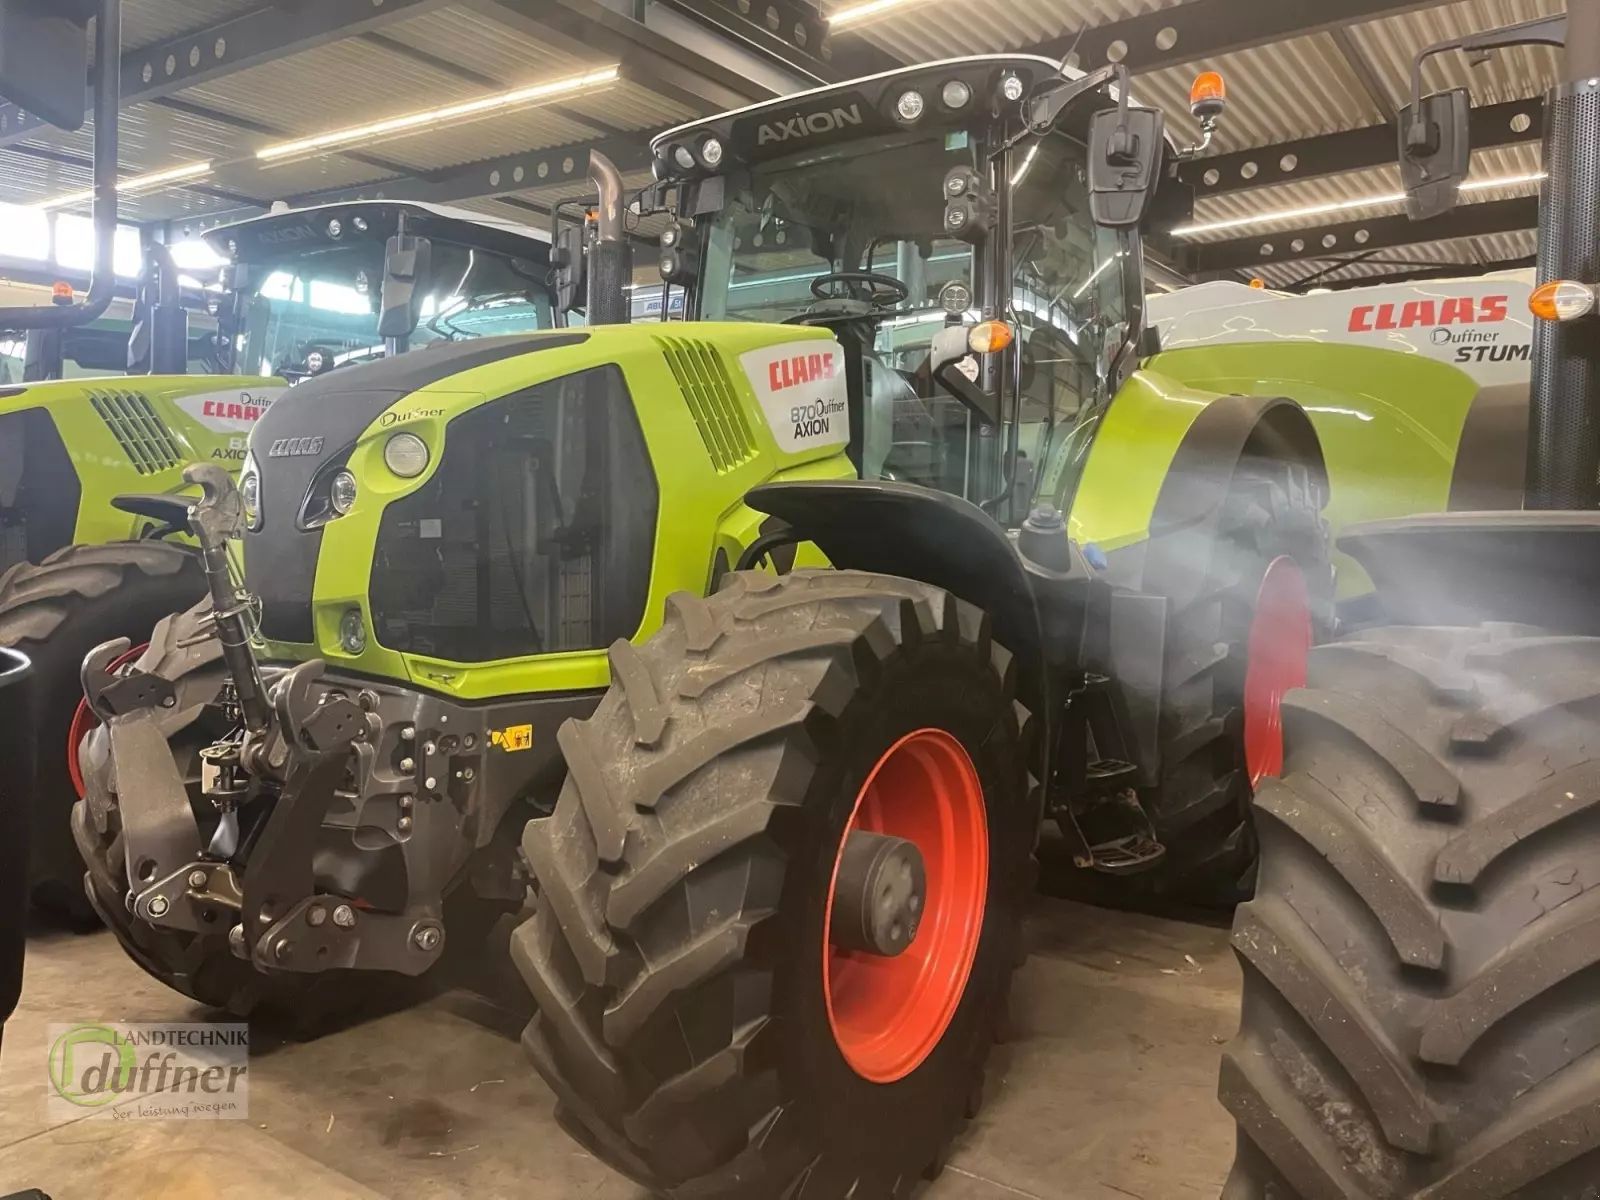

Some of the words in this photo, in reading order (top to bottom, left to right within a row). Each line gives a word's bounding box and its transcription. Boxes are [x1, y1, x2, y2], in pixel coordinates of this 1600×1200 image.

[757, 104, 863, 145] AXION
[1348, 296, 1508, 332] CLAAS
[1430, 327, 1500, 346] Duffner
[1454, 345, 1532, 362] STUM
[769, 353, 833, 392] CLAAS
[203, 400, 267, 421] CLAA
[791, 405, 815, 423] 870
[794, 417, 829, 439] AXION
[269, 436, 324, 456] CLAAS
